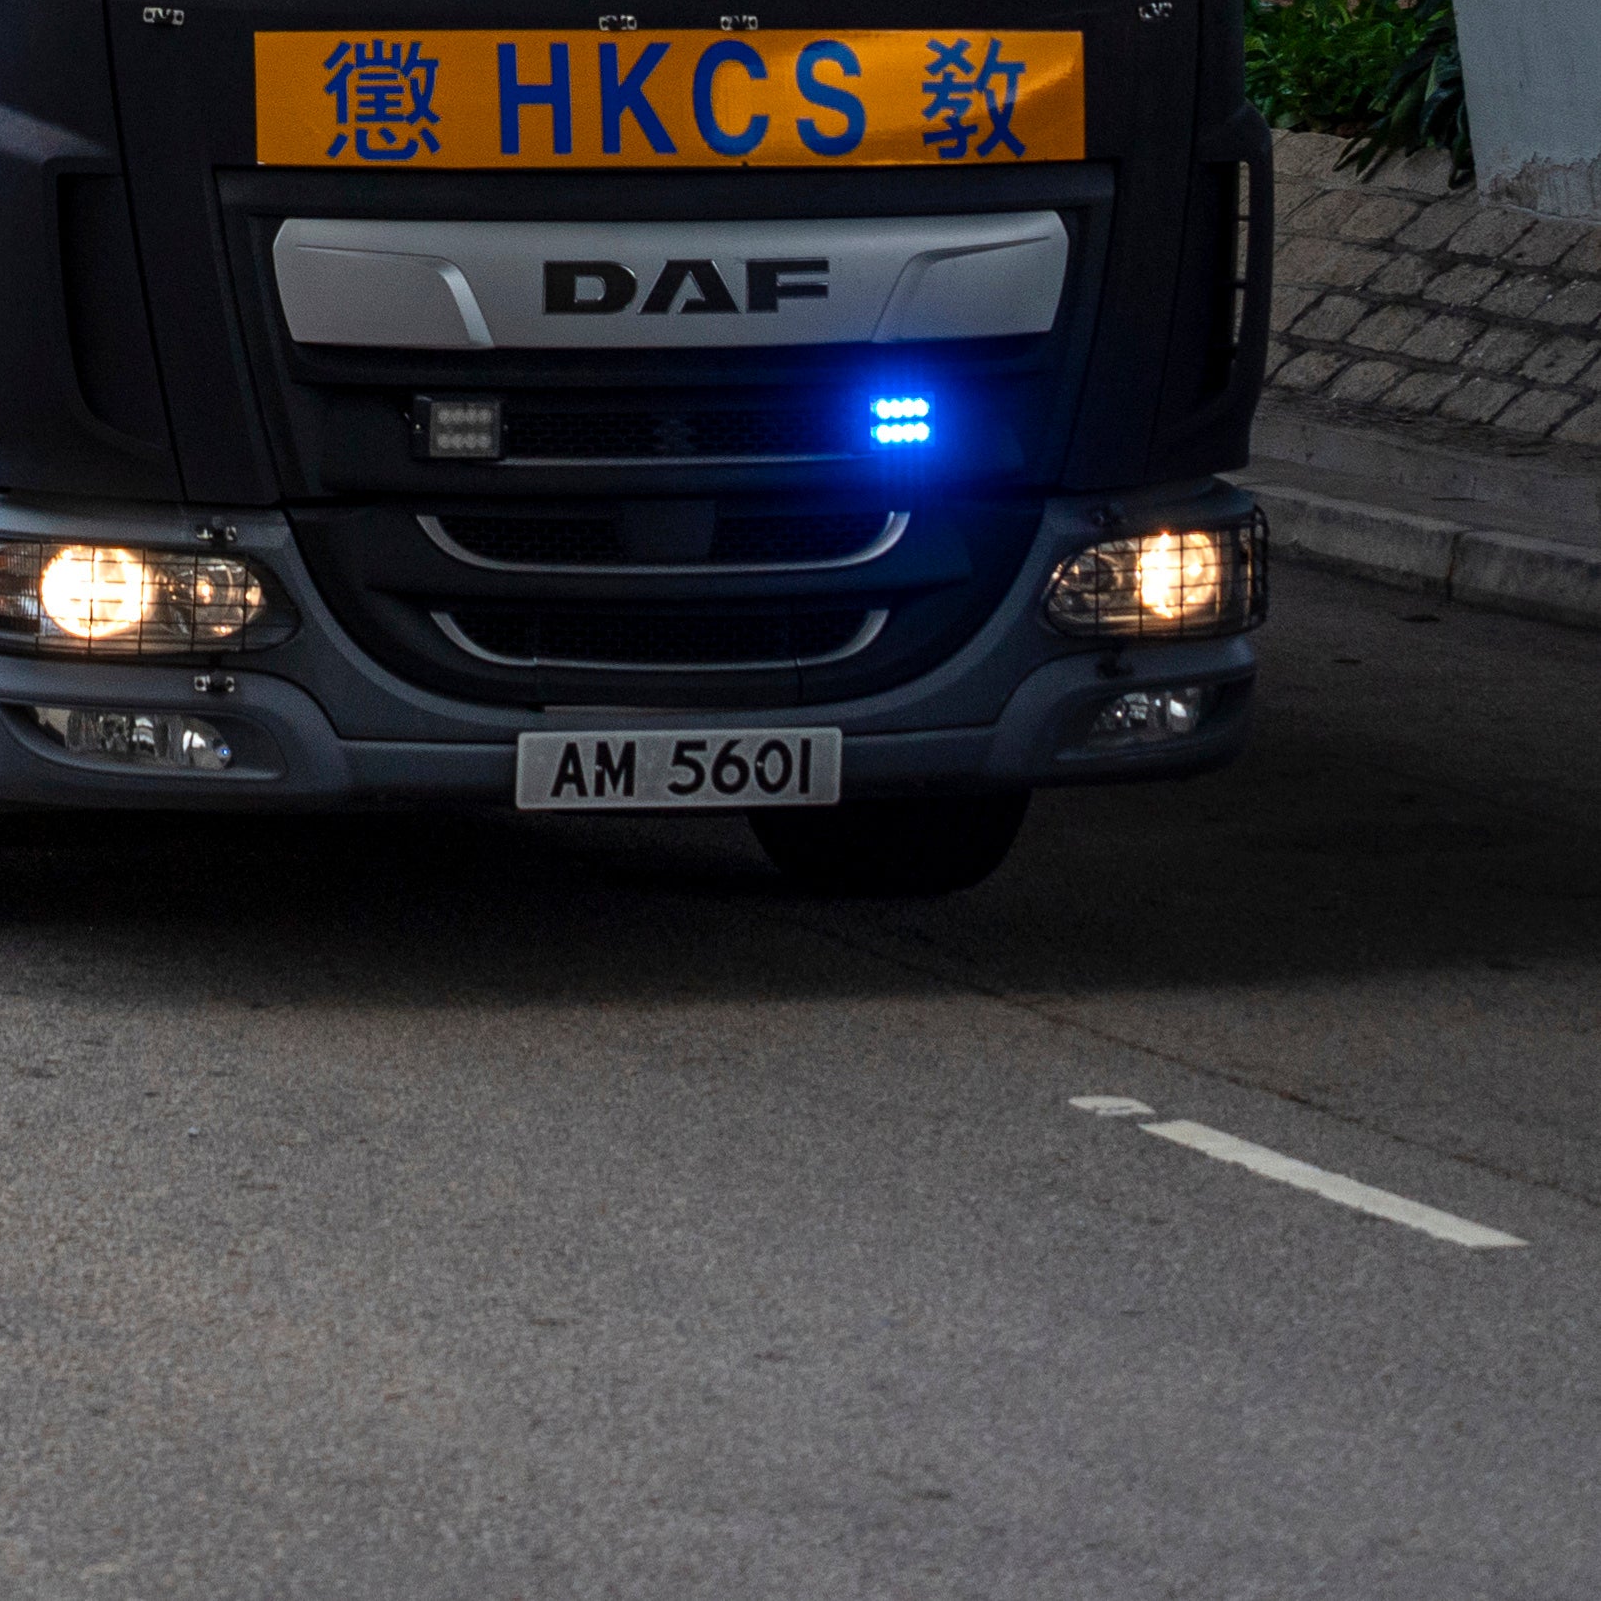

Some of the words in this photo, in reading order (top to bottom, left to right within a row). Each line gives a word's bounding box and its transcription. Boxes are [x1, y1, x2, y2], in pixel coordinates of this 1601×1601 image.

[323, 38, 442, 162] 懲
[498, 38, 867, 158] HKCS
[541, 257, 830, 315] DAF
[549, 739, 636, 799] AM
[665, 736, 813, 797] 5601
